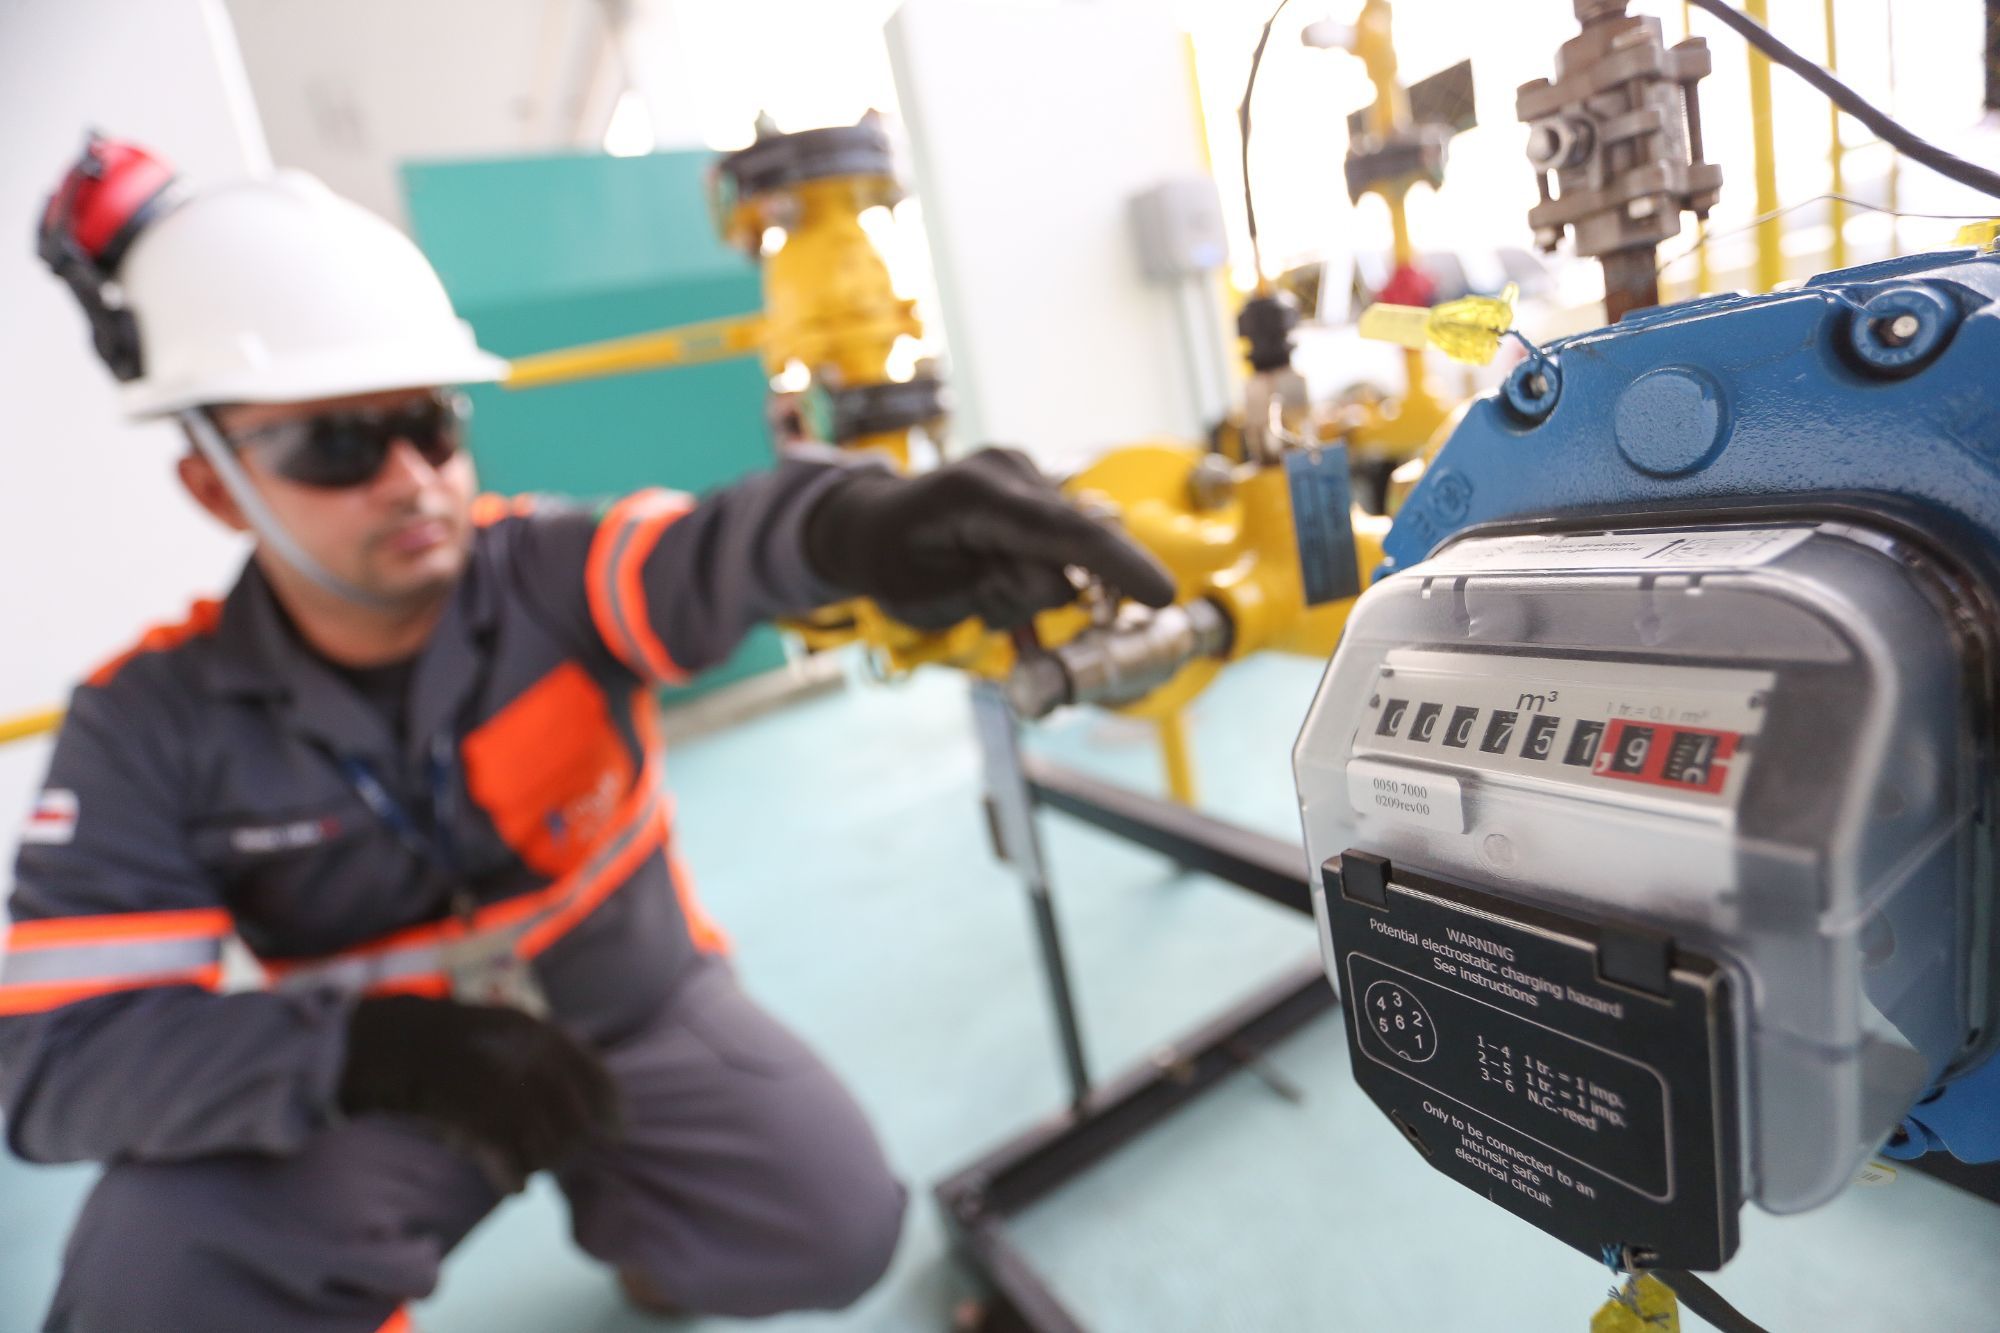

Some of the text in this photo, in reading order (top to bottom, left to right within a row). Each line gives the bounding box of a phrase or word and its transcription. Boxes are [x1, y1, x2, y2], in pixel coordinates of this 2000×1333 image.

[1373, 777, 1427, 799] 0050 7000
[1370, 918, 1624, 1019] Potential electrostatic charging hazard
[1446, 927, 1515, 962] WARNING
[1433, 957, 1540, 1007] See instructions
[1376, 991, 1424, 1028] 4 3 2
[1379, 1014, 1423, 1049] 5 6 1
[1422, 1100, 1596, 1200] Only to be connected to an
[1461, 1134, 1541, 1186] intrinsic safe
[1455, 1147, 1553, 1208] electrical circuit
